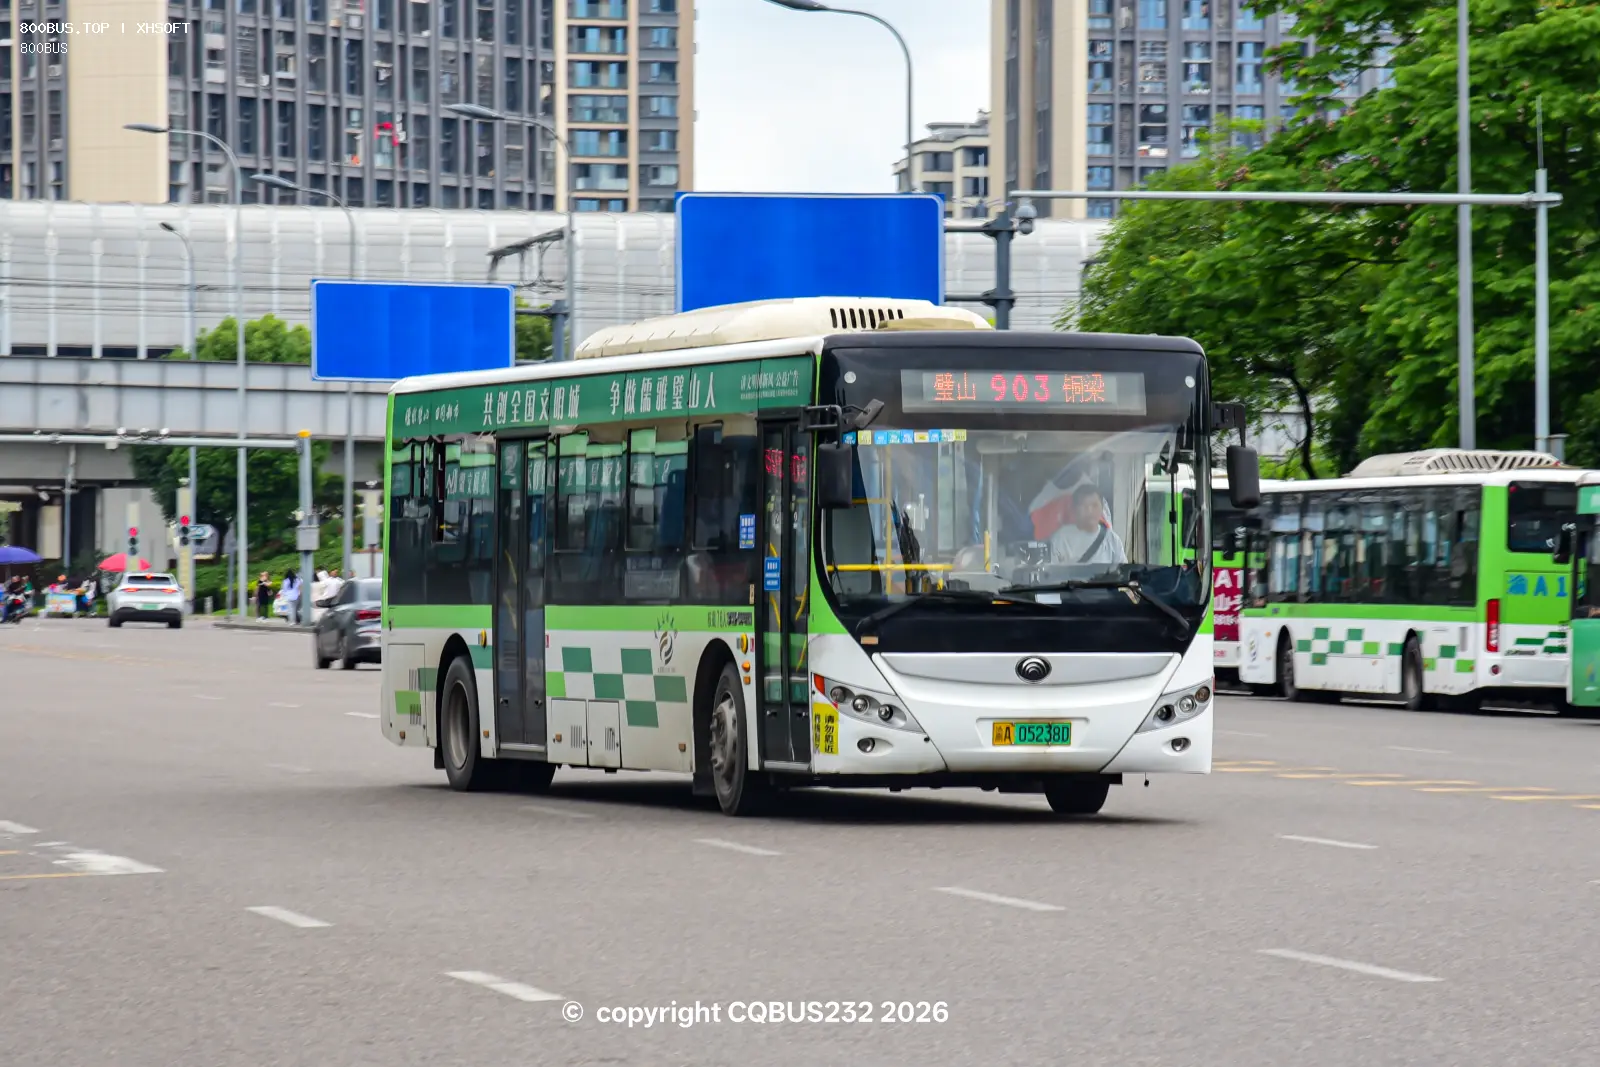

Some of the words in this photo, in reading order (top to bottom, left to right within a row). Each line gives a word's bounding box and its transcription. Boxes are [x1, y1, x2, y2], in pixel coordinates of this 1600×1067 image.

[482, 384, 581, 426] 共创全国文明城
[609, 371, 716, 416] 争做儒雅璧山人
[933, 373, 976, 401] 璧山
[990, 374, 1050, 402] 903
[1062, 373, 1105, 402] 铜梁
